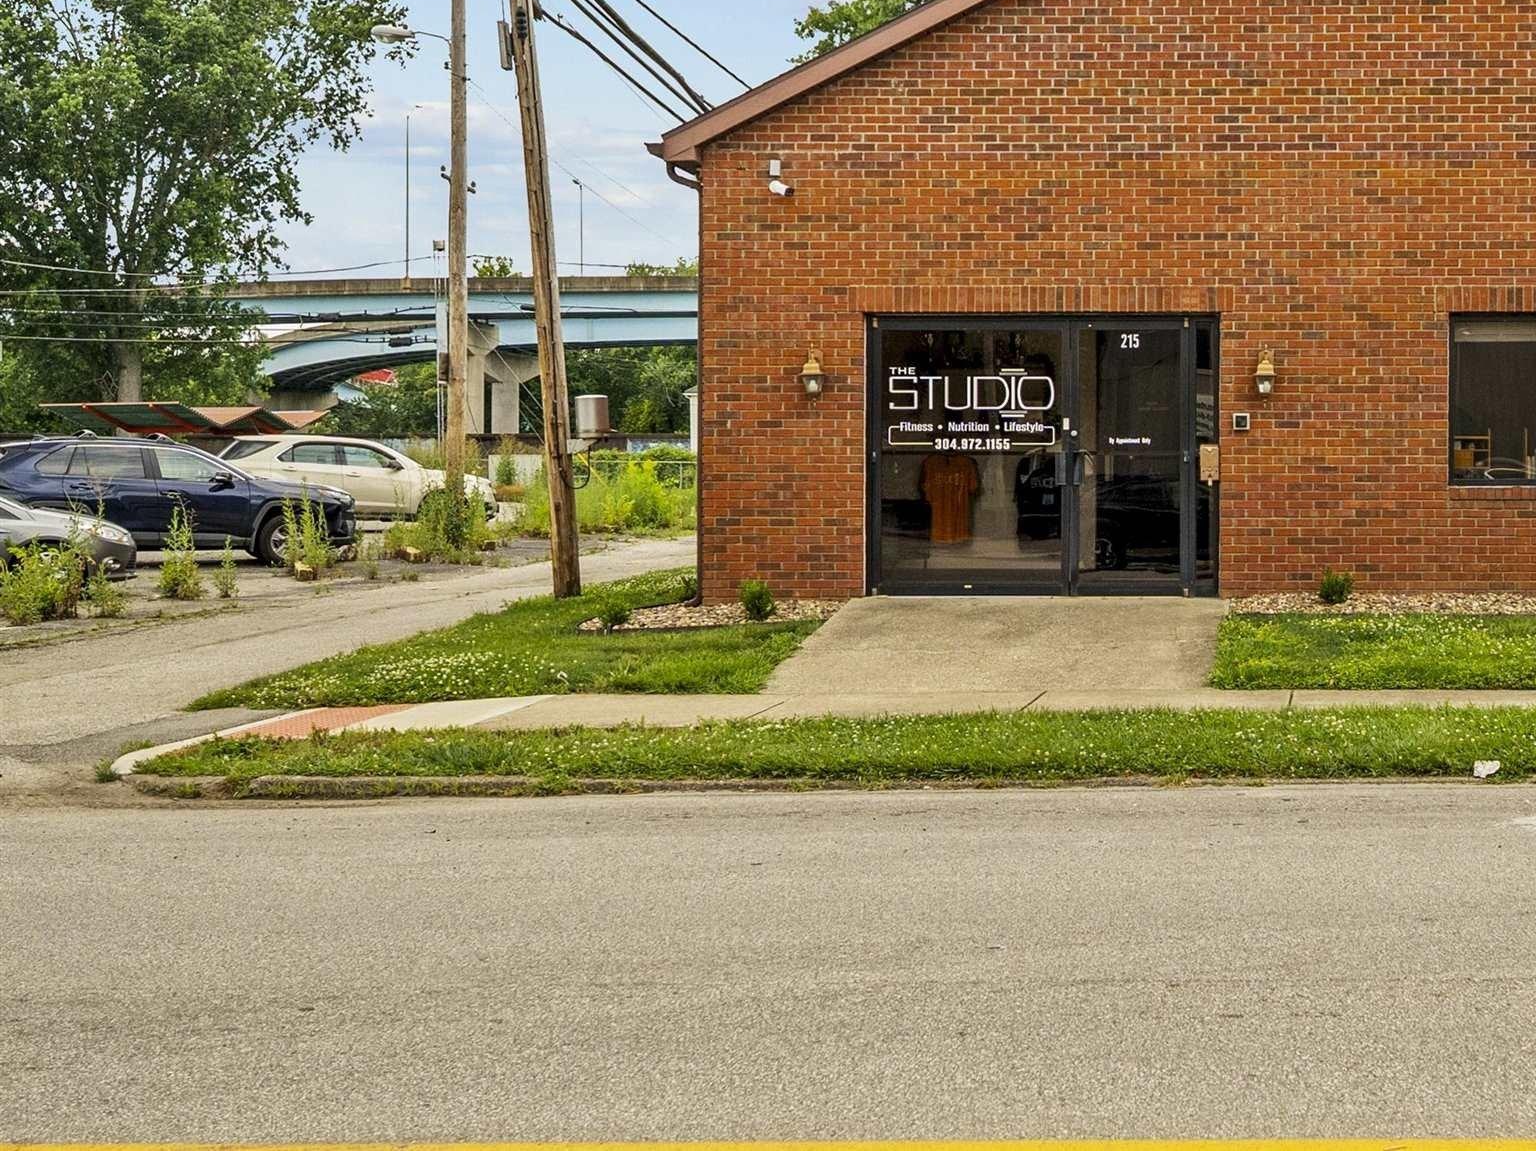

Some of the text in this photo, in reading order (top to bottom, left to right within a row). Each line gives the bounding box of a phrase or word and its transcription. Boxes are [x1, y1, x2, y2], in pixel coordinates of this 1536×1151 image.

[1120, 333, 1140, 349] 215
[889, 366, 916, 375] THE
[888, 376, 1055, 410] STUDIO
[900, 422, 1044, 433] Fitness Nutrition Lifestyle
[934, 438, 1011, 450] 304.972.1155
